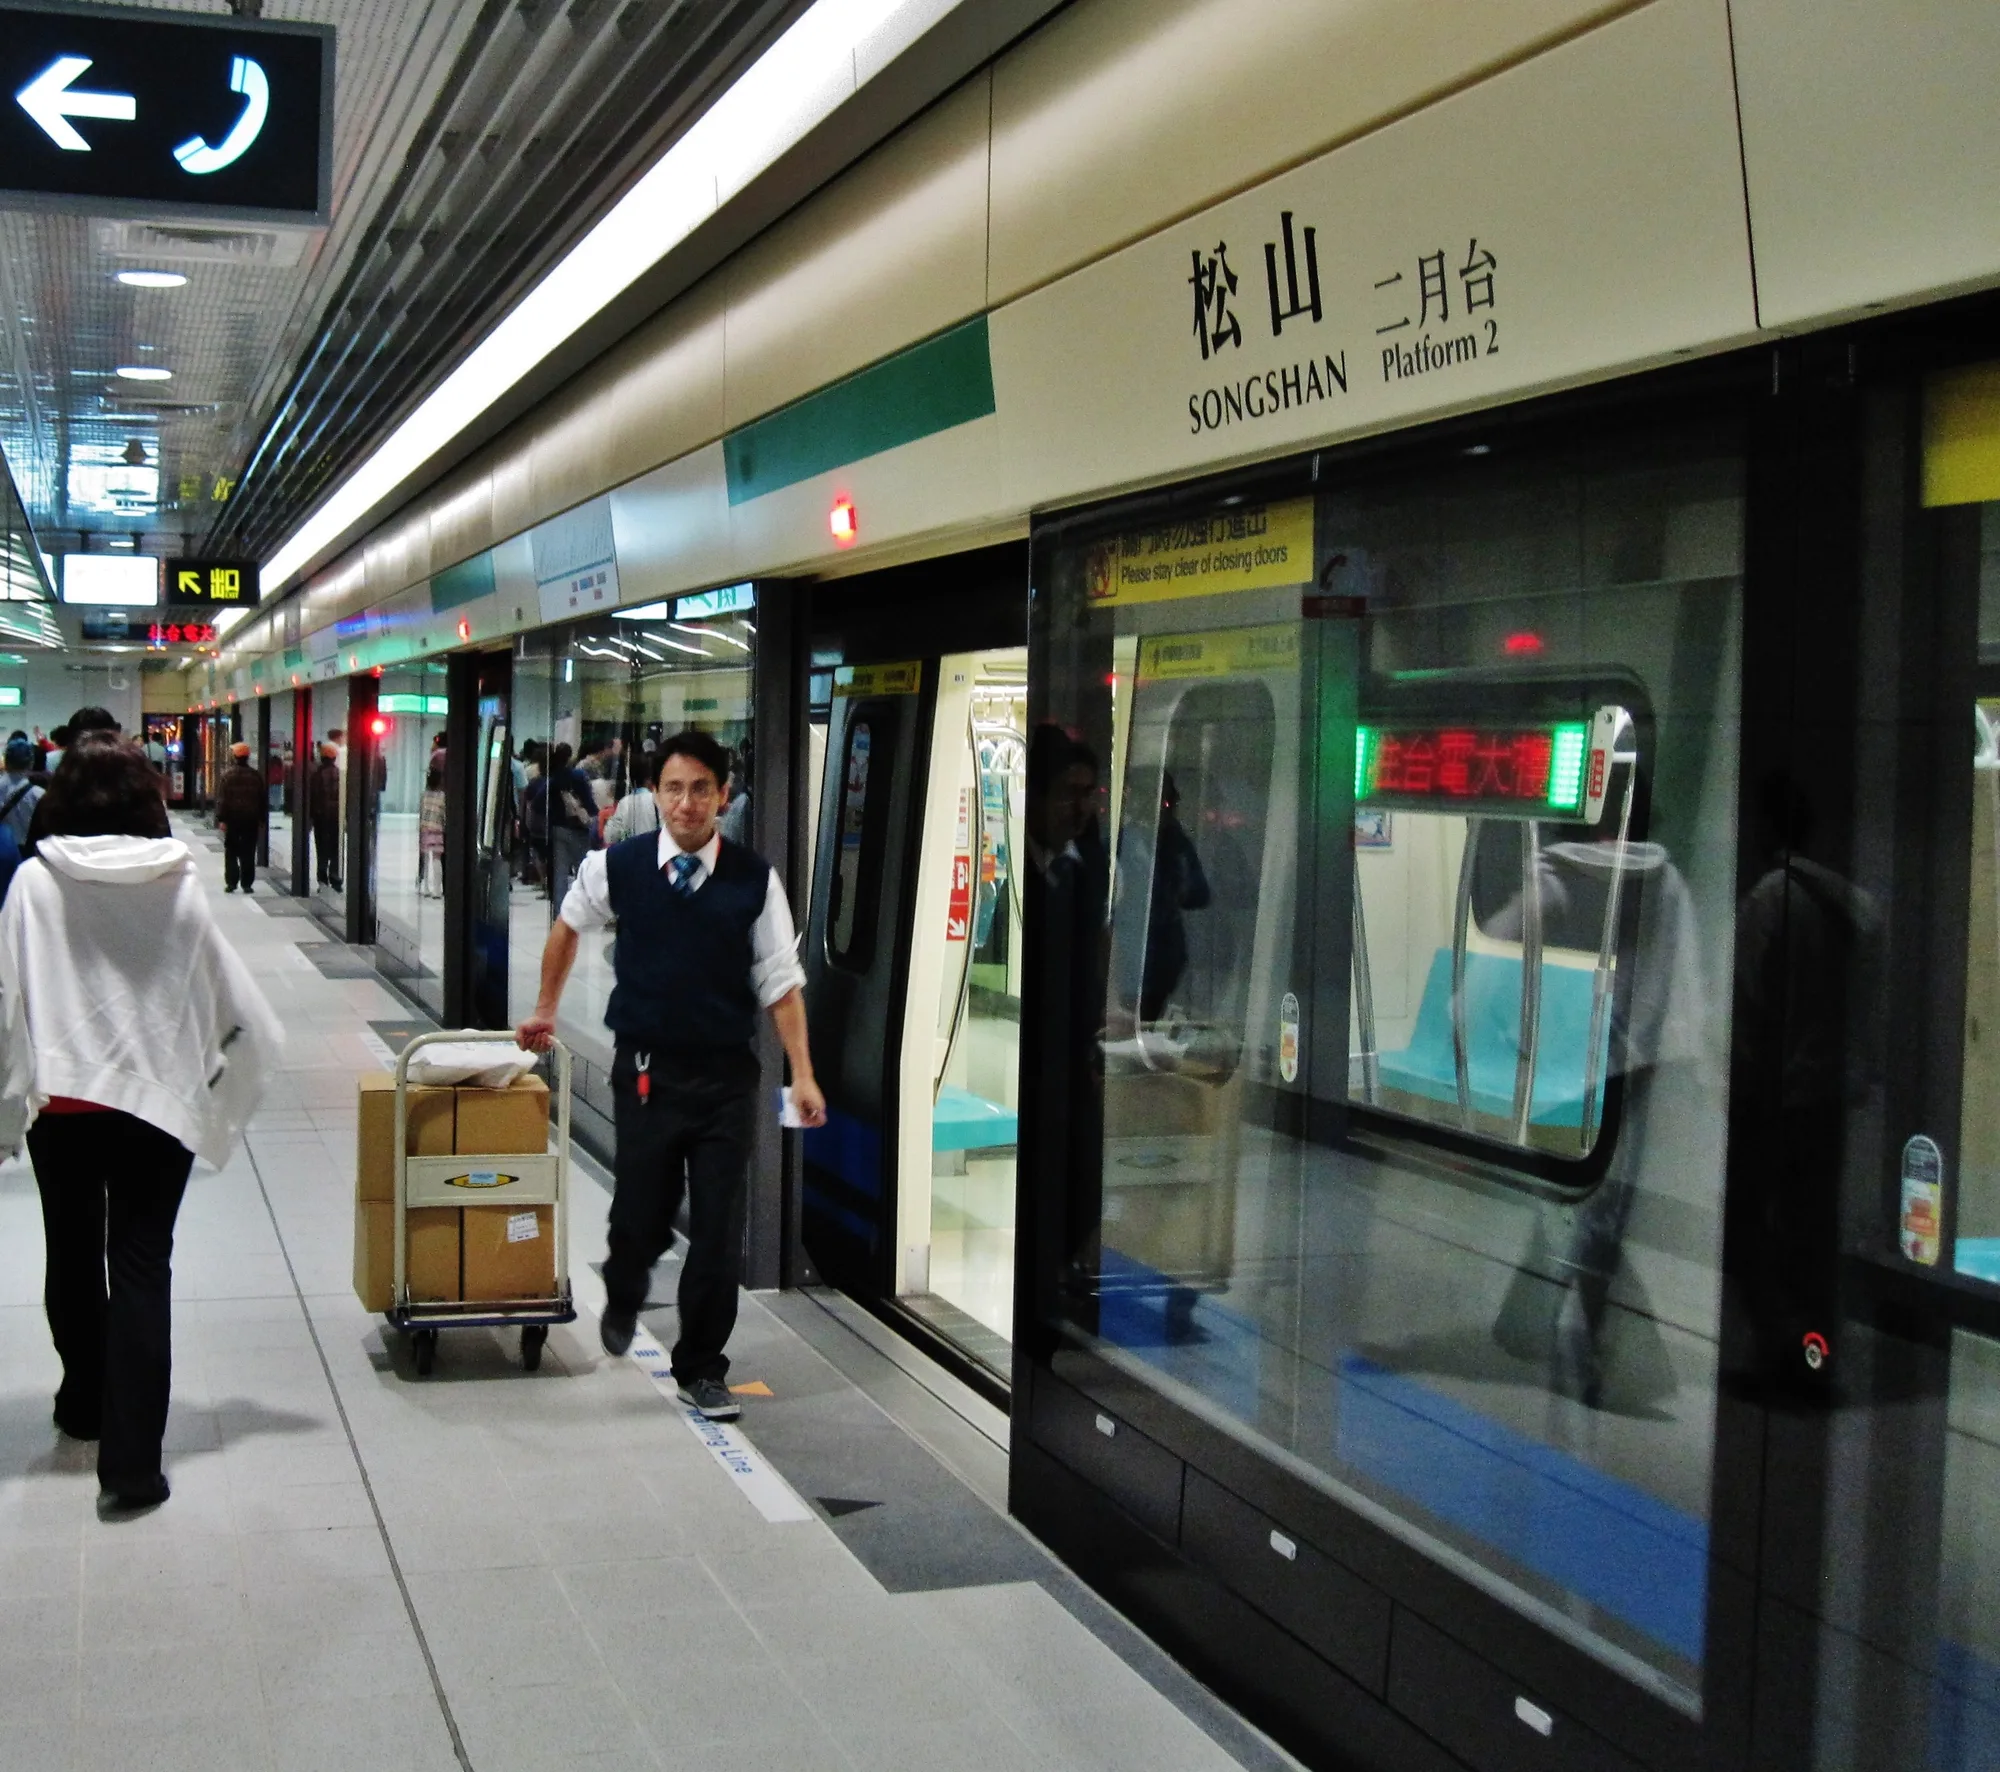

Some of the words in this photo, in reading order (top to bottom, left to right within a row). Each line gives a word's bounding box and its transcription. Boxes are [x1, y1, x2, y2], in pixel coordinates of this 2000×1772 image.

[1187, 210, 1323, 361] 松山
[1374, 238, 1498, 336] 二月台
[1382, 331, 1477, 382] Platform
[1484, 319, 1499, 356] 2
[1188, 350, 1348, 434] SONGSHAN
[210, 568, 240, 599] 出口
[1121, 563, 1152, 586] Please
[1153, 562, 1173, 584] stay
[1175, 556, 1199, 578] clear
[1200, 553, 1212, 574] of
[1212, 549, 1252, 573] closing
[1254, 543, 1288, 565] doors
[720, 1449, 753, 1474] Line
